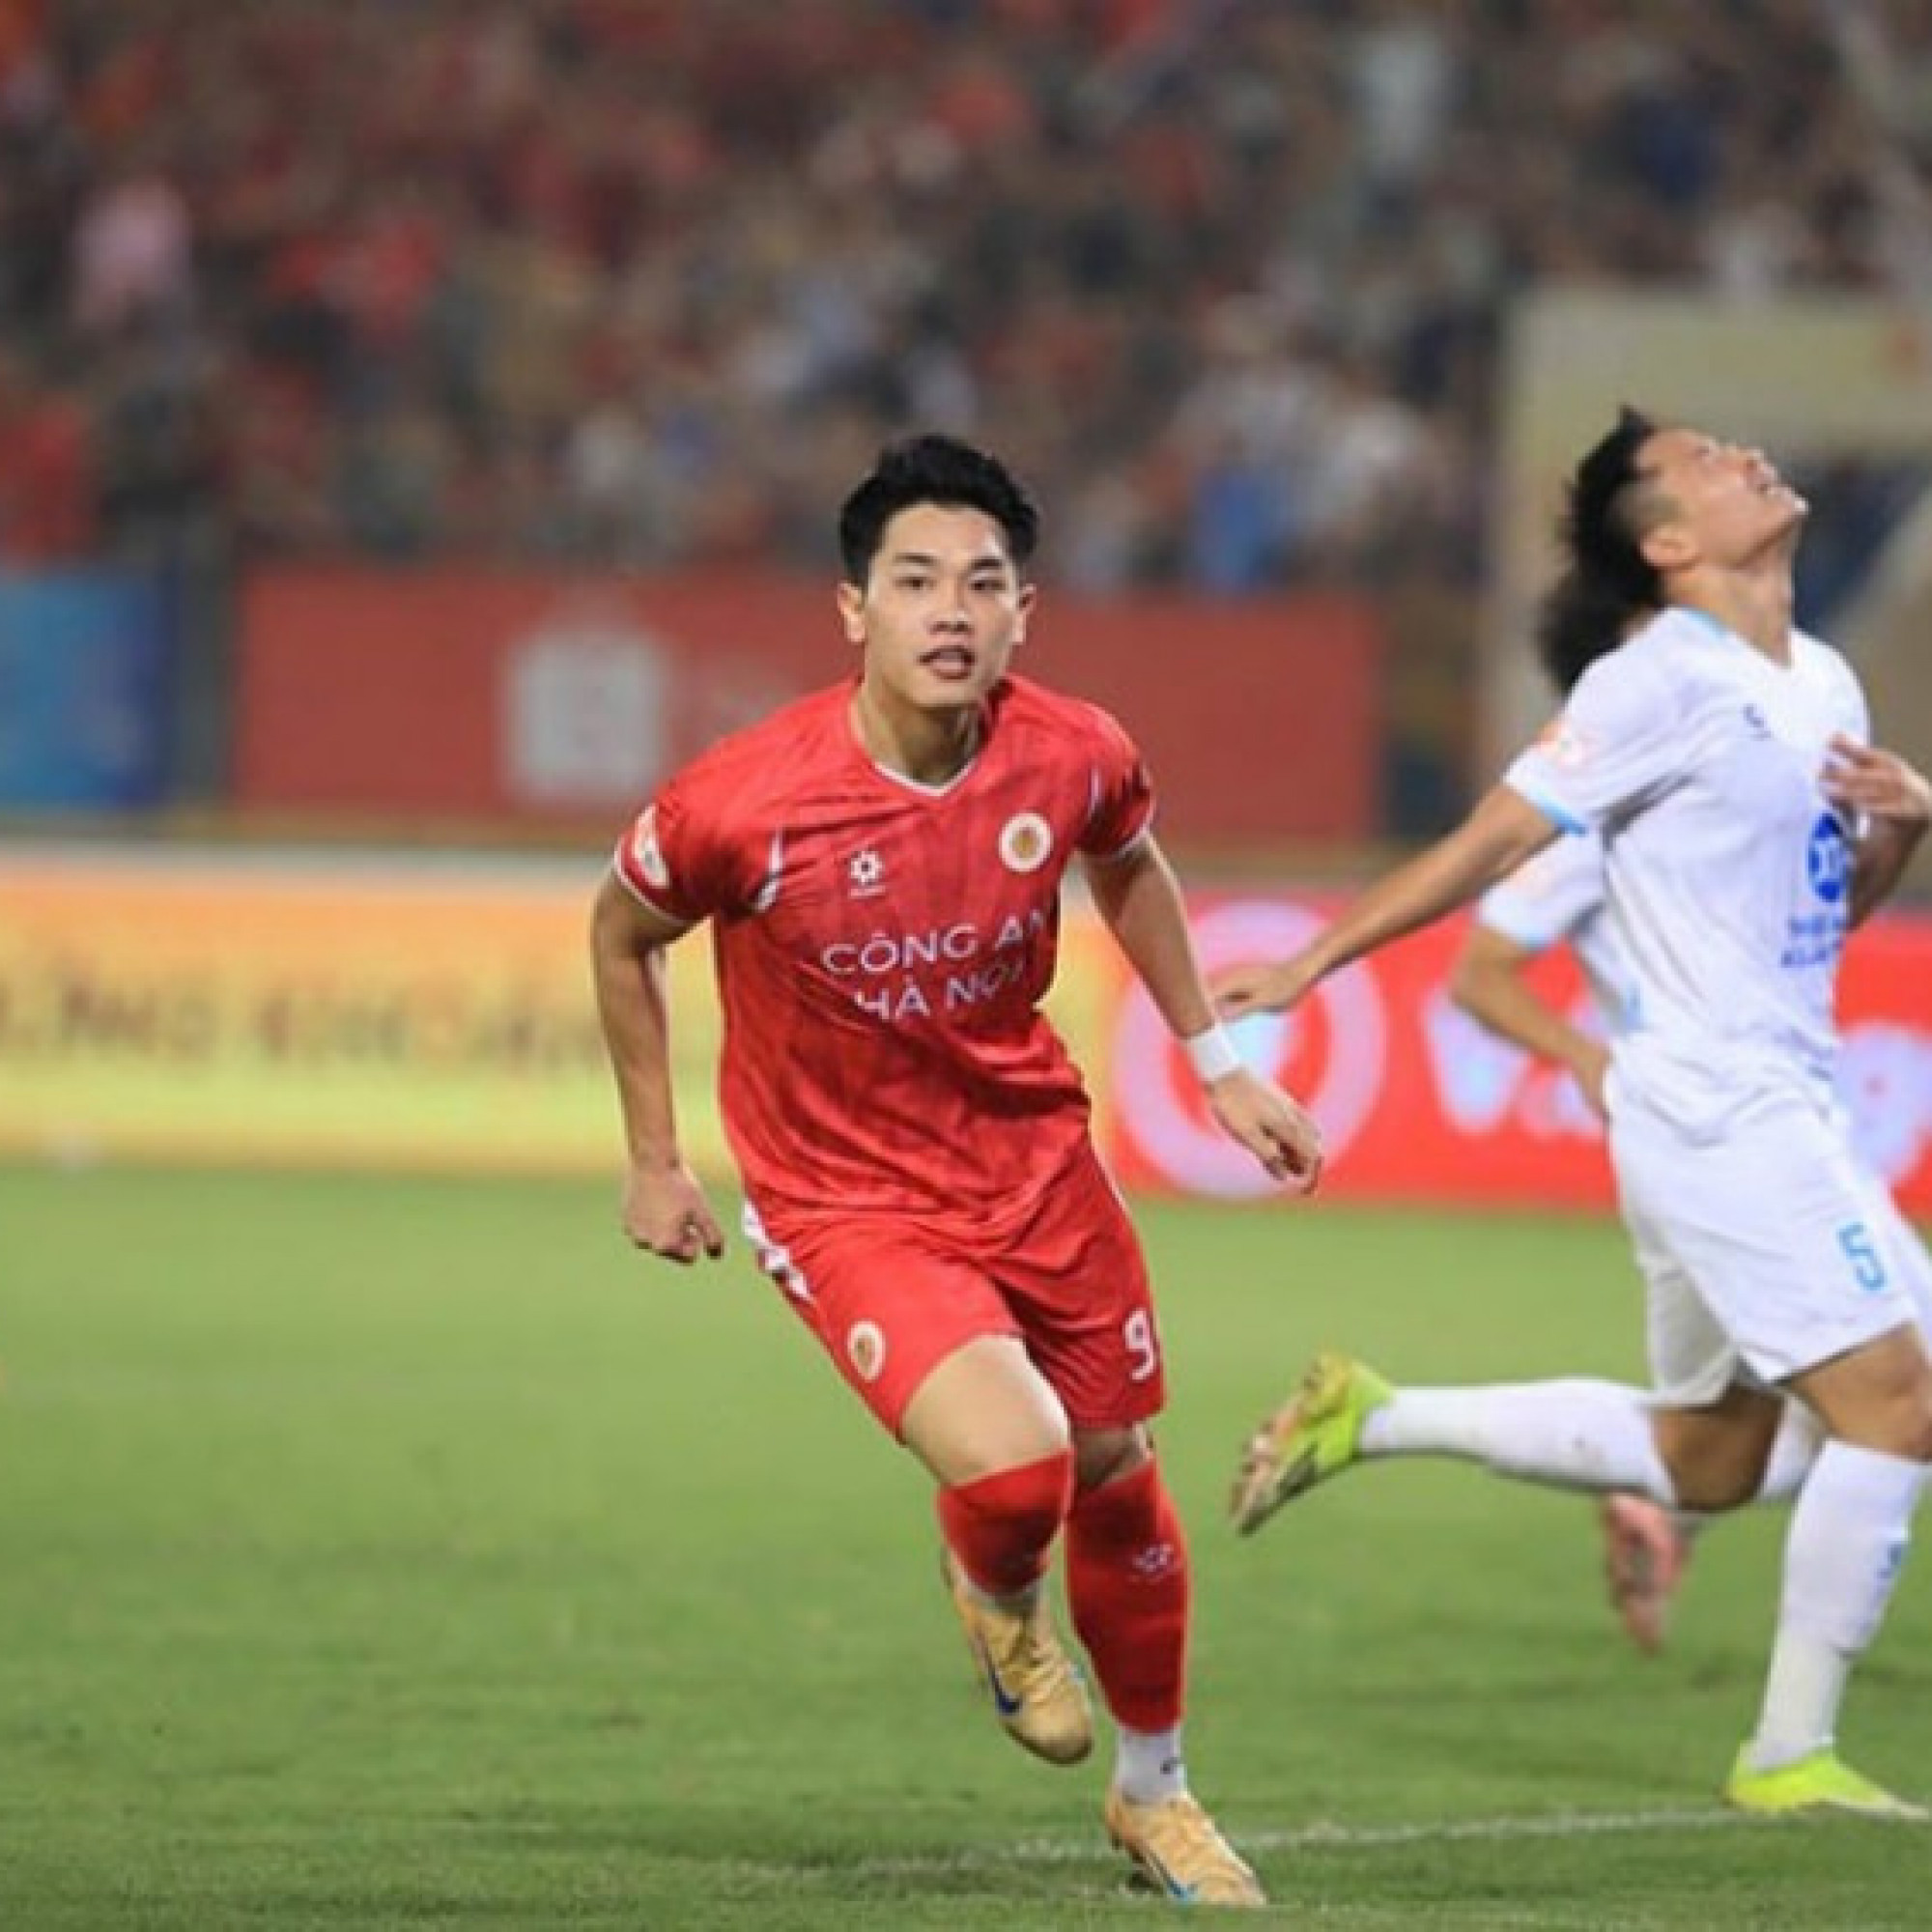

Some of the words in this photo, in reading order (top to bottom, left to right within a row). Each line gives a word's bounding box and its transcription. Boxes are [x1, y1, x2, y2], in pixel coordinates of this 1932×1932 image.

[822, 923, 979, 972] CÔNG
[854, 975, 931, 1021] HÀ
[1836, 1221, 1887, 1291] 5
[1124, 1307, 1154, 1380] 9
